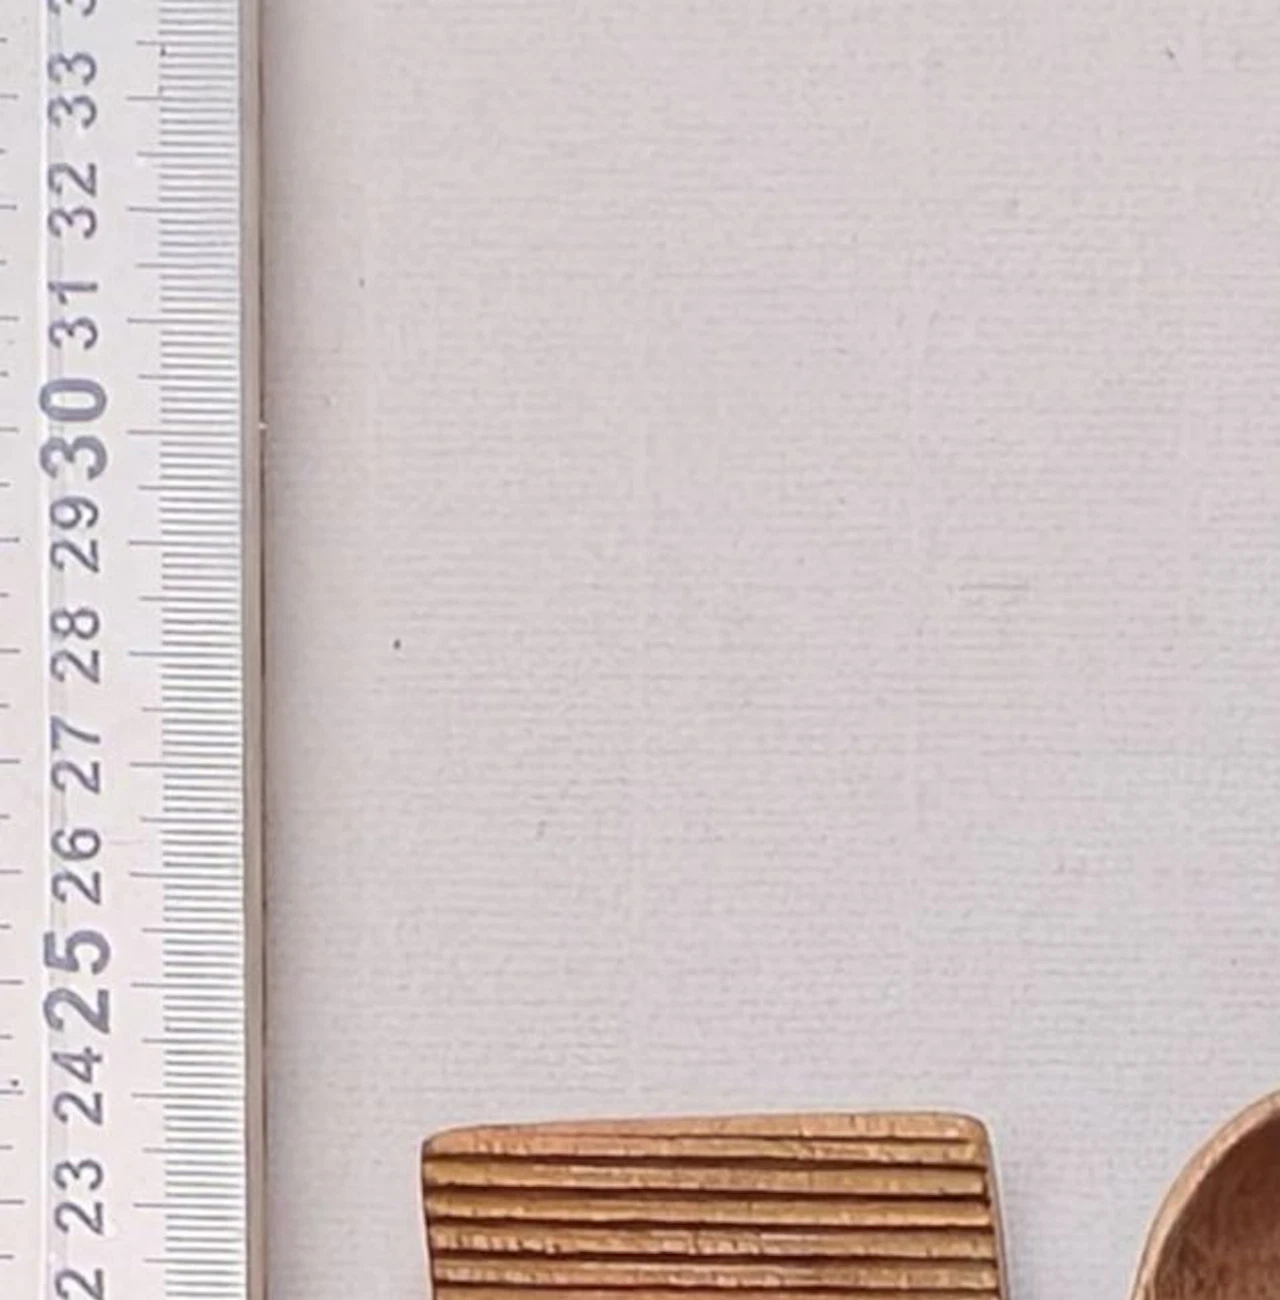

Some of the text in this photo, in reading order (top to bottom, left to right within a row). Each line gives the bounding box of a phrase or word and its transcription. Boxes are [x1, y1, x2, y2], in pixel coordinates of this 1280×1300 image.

[47, 52, 97, 129] 33
[47, 163, 97, 239] 32
[47, 281, 98, 351] 31
[38, 378, 108, 481] 30
[49, 496, 100, 574] 29
[49, 607, 100, 685] 28
[50, 715, 101, 796] 27
[50, 828, 102, 905] 26
[43, 930, 110, 1035] 25
[51, 1046, 103, 1126] 24
[52, 1159, 104, 1235] 23
